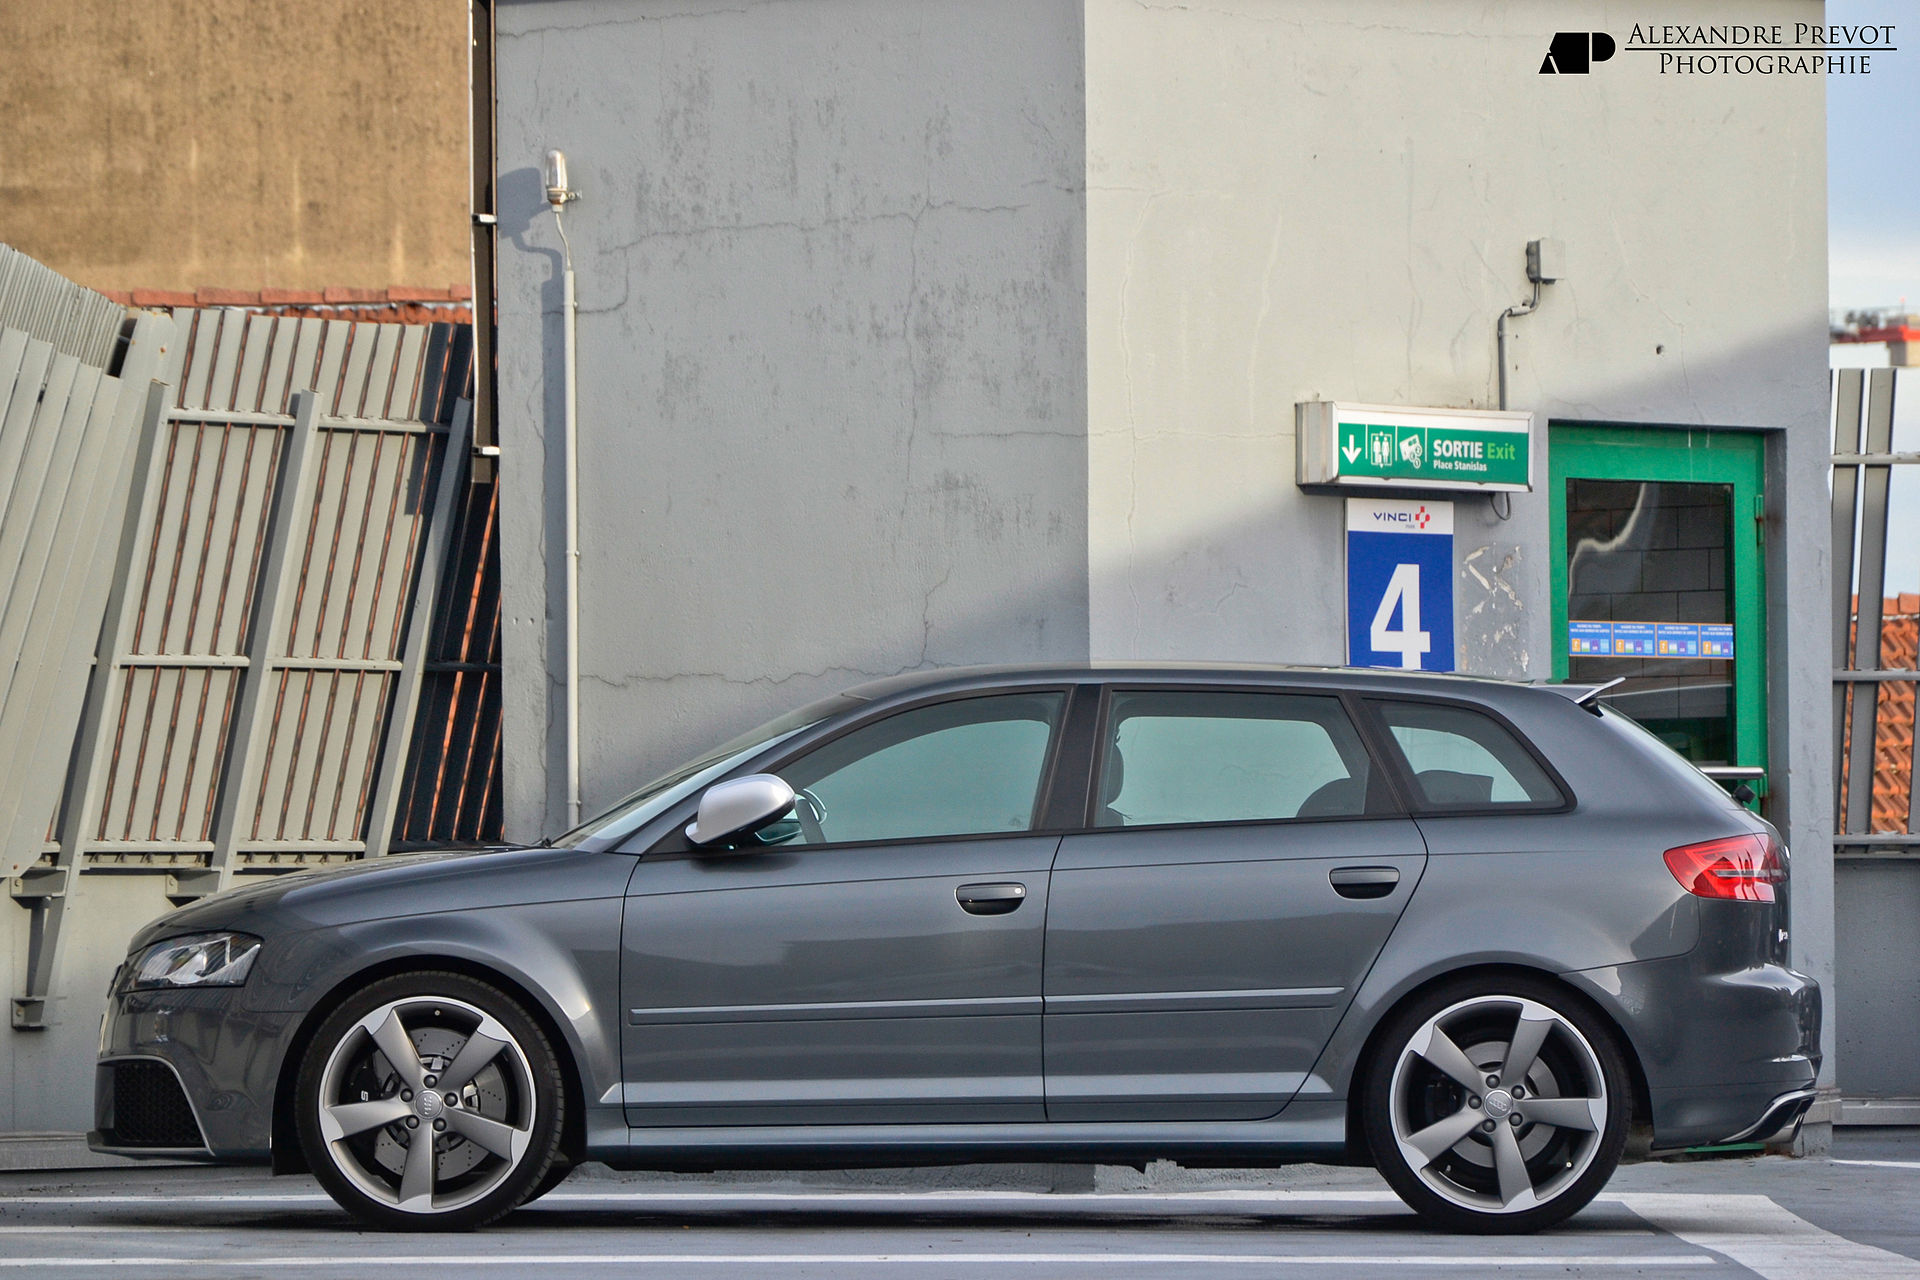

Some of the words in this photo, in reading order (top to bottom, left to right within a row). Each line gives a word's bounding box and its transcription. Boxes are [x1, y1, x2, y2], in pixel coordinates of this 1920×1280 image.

[1433, 439, 1483, 459] SORTIE
[1487, 442, 1516, 460] Exit
[1433, 459, 1453, 470] Place
[1454, 460, 1488, 471] Stanislas
[1373, 512, 1411, 523] VINCI
[1370, 563, 1431, 670] 4
